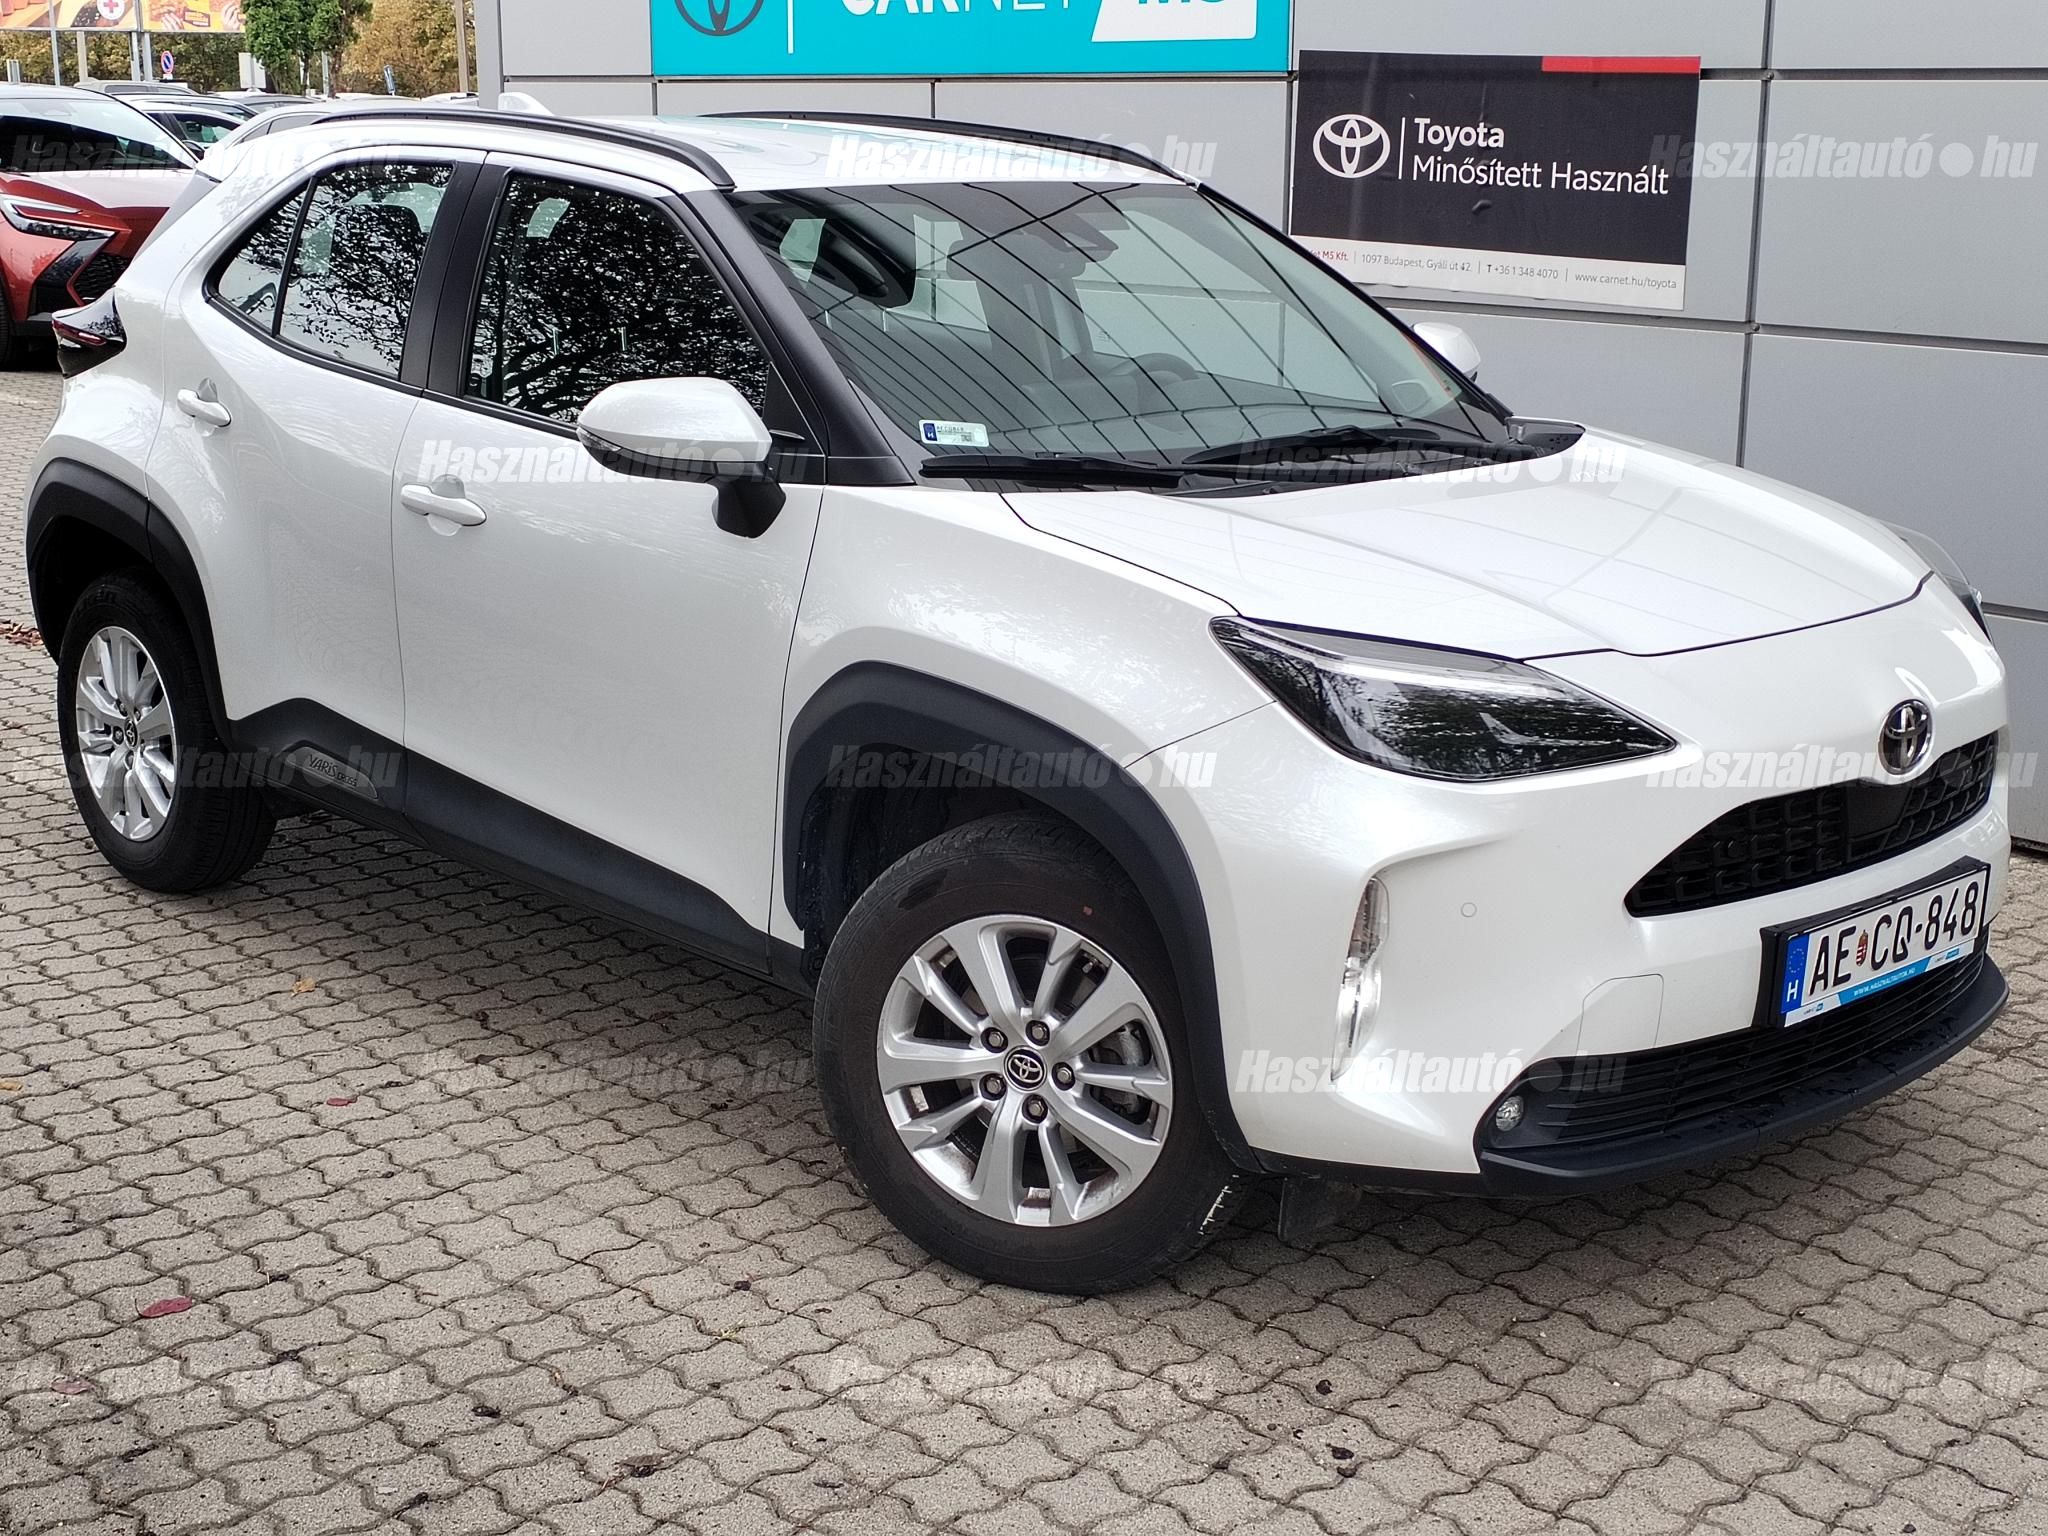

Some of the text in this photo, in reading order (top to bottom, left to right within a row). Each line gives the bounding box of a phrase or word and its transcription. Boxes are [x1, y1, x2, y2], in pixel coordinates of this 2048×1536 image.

[1414, 117, 1505, 149] Toyota
[1412, 154, 1669, 195] Minősített Használt
[1362, 254, 1383, 264] 1097
[1519, 268, 1535, 278] 348
[1536, 268, 1559, 280] 4070
[1808, 925, 1857, 996] AE
[1785, 979, 1799, 1003] H
